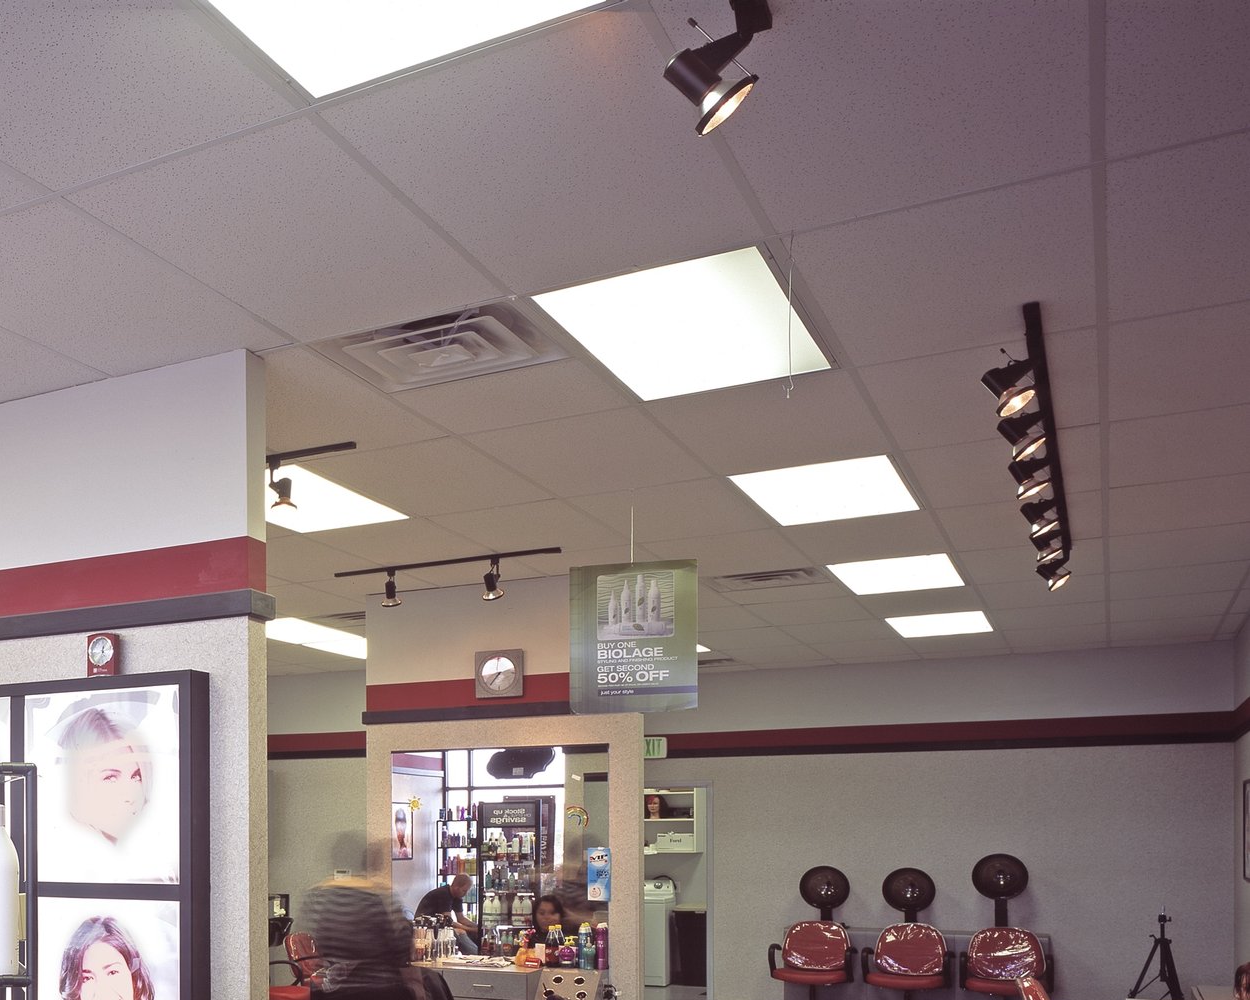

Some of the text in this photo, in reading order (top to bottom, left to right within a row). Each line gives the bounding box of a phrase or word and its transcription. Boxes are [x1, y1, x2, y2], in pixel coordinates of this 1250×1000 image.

[597, 647, 663, 659] BIOLAGE
[597, 670, 669, 683] 50% OFF
